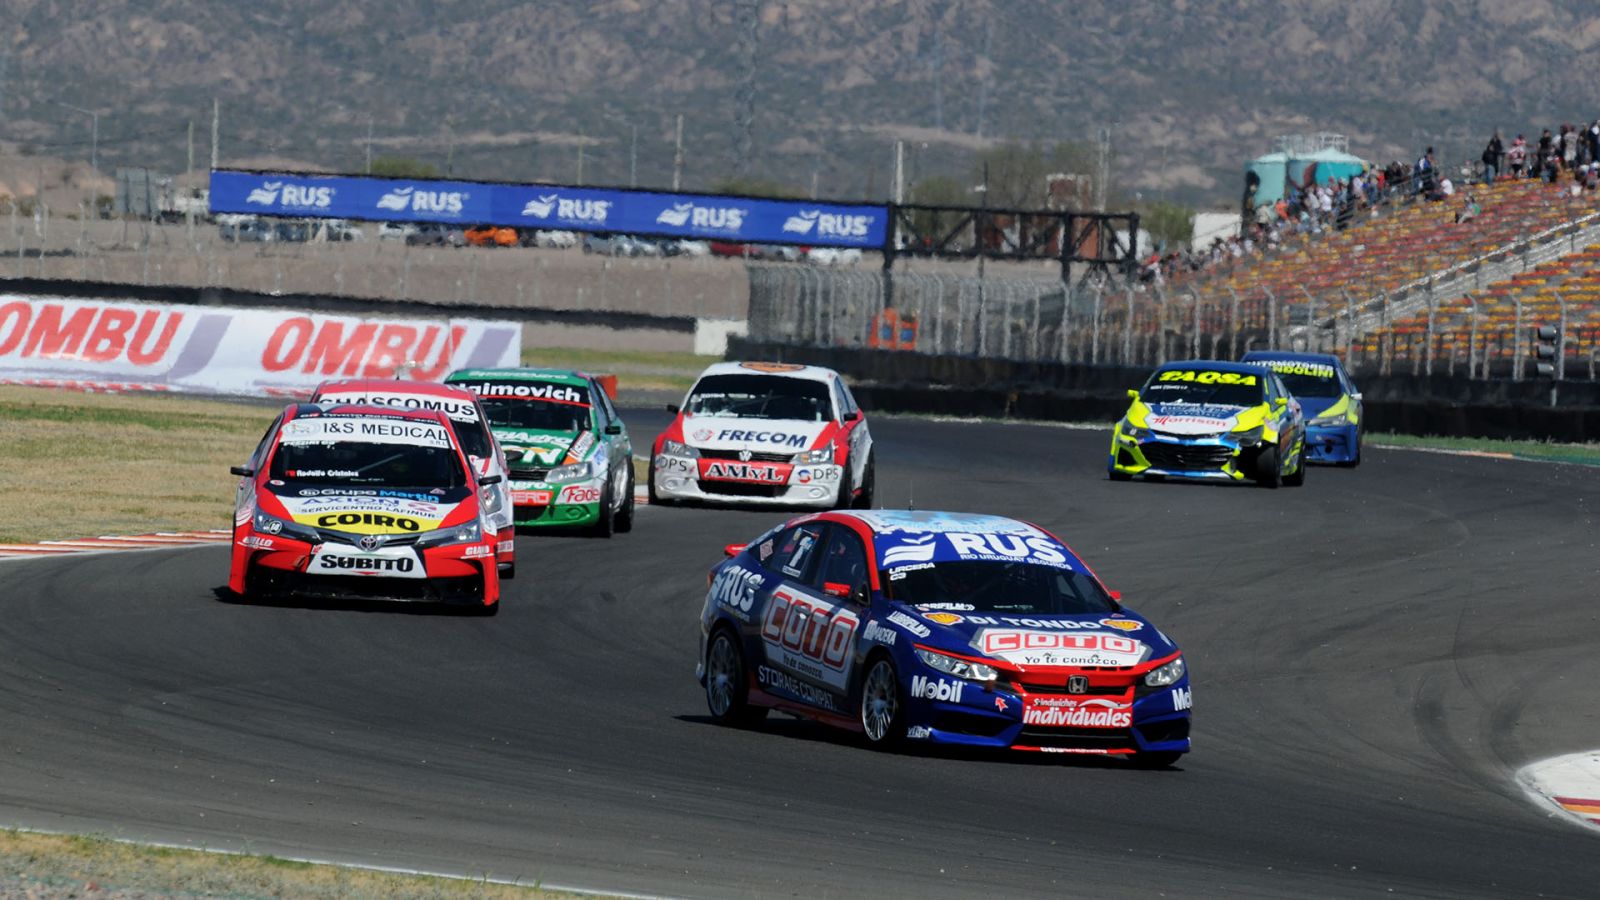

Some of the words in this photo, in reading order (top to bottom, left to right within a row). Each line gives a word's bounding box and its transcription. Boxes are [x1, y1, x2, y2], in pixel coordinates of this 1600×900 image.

[281, 184, 332, 207] RUS
[412, 191, 464, 212] RUS
[557, 199, 609, 222] RUS
[692, 206, 744, 230] RUS
[817, 213, 868, 236] RUS
[0, 301, 185, 366] OMBU
[261, 316, 468, 381] OMBU
[1159, 371, 1256, 386] TAQSA
[323, 422, 354, 434] I&S
[361, 424, 447, 440] MEDICAL
[718, 430, 808, 449] FRECOM
[813, 468, 839, 480] DPS
[321, 488, 377, 497] Grupo
[301, 505, 383, 513] SERVICENTRO
[318, 513, 420, 531] COIRO
[945, 532, 1066, 564] RUS
[980, 554, 1025, 562] URUGUAY
[1027, 557, 1073, 571] SEGUROS
[719, 566, 764, 612] RUS
[761, 591, 859, 669] COTO
[965, 615, 998, 625] DI
[1001, 618, 1103, 631] TONDO
[986, 632, 1140, 654] COTO
[1024, 656, 1040, 664] Yo
[1045, 655, 1058, 664] te
[911, 675, 963, 703] Mobil
[1022, 705, 1132, 728] individuales
